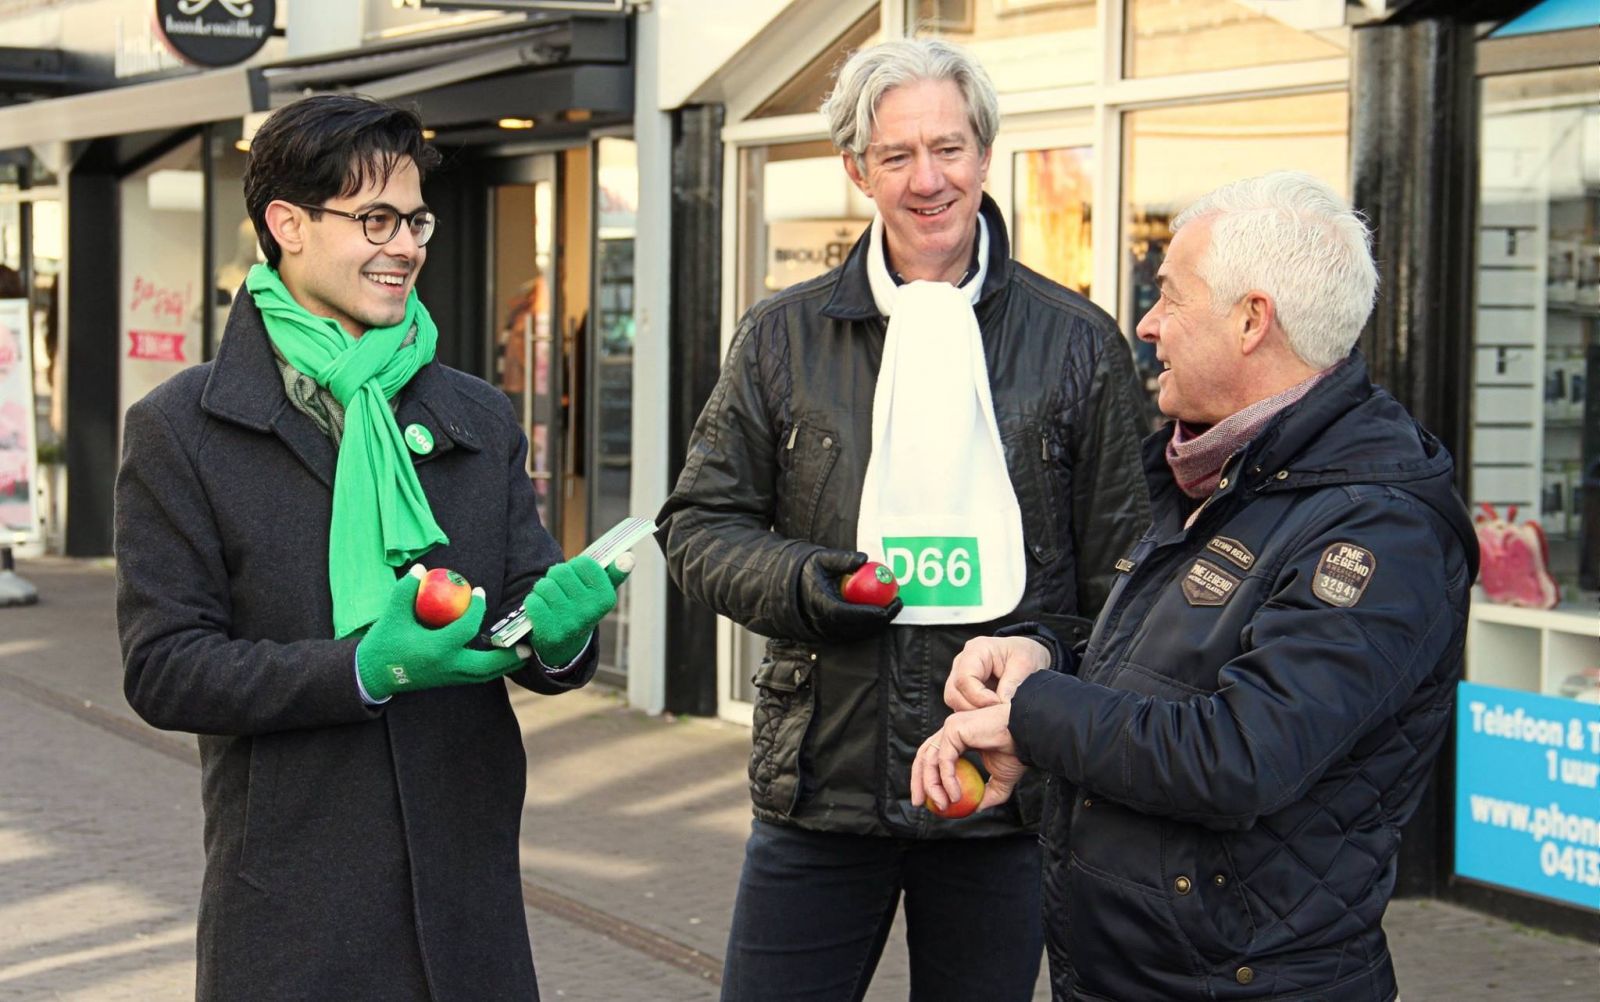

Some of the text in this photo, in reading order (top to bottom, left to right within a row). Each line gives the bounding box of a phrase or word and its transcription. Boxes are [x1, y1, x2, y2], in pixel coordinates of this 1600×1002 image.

[405, 423, 432, 451] D66
[886, 547, 971, 587] D66
[1230, 547, 1251, 564] RELIC
[1326, 553, 1369, 577] LEGEND
[1339, 546, 1364, 562] PME
[1203, 570, 1233, 592] LEGEND
[1321, 576, 1356, 599] 32941
[1470, 701, 1564, 748] Telefoon
[1567, 717, 1585, 750] &
[1546, 749, 1599, 788] 1 uur
[1470, 795, 1600, 848] www.phon
[1540, 841, 1600, 888] 0413
